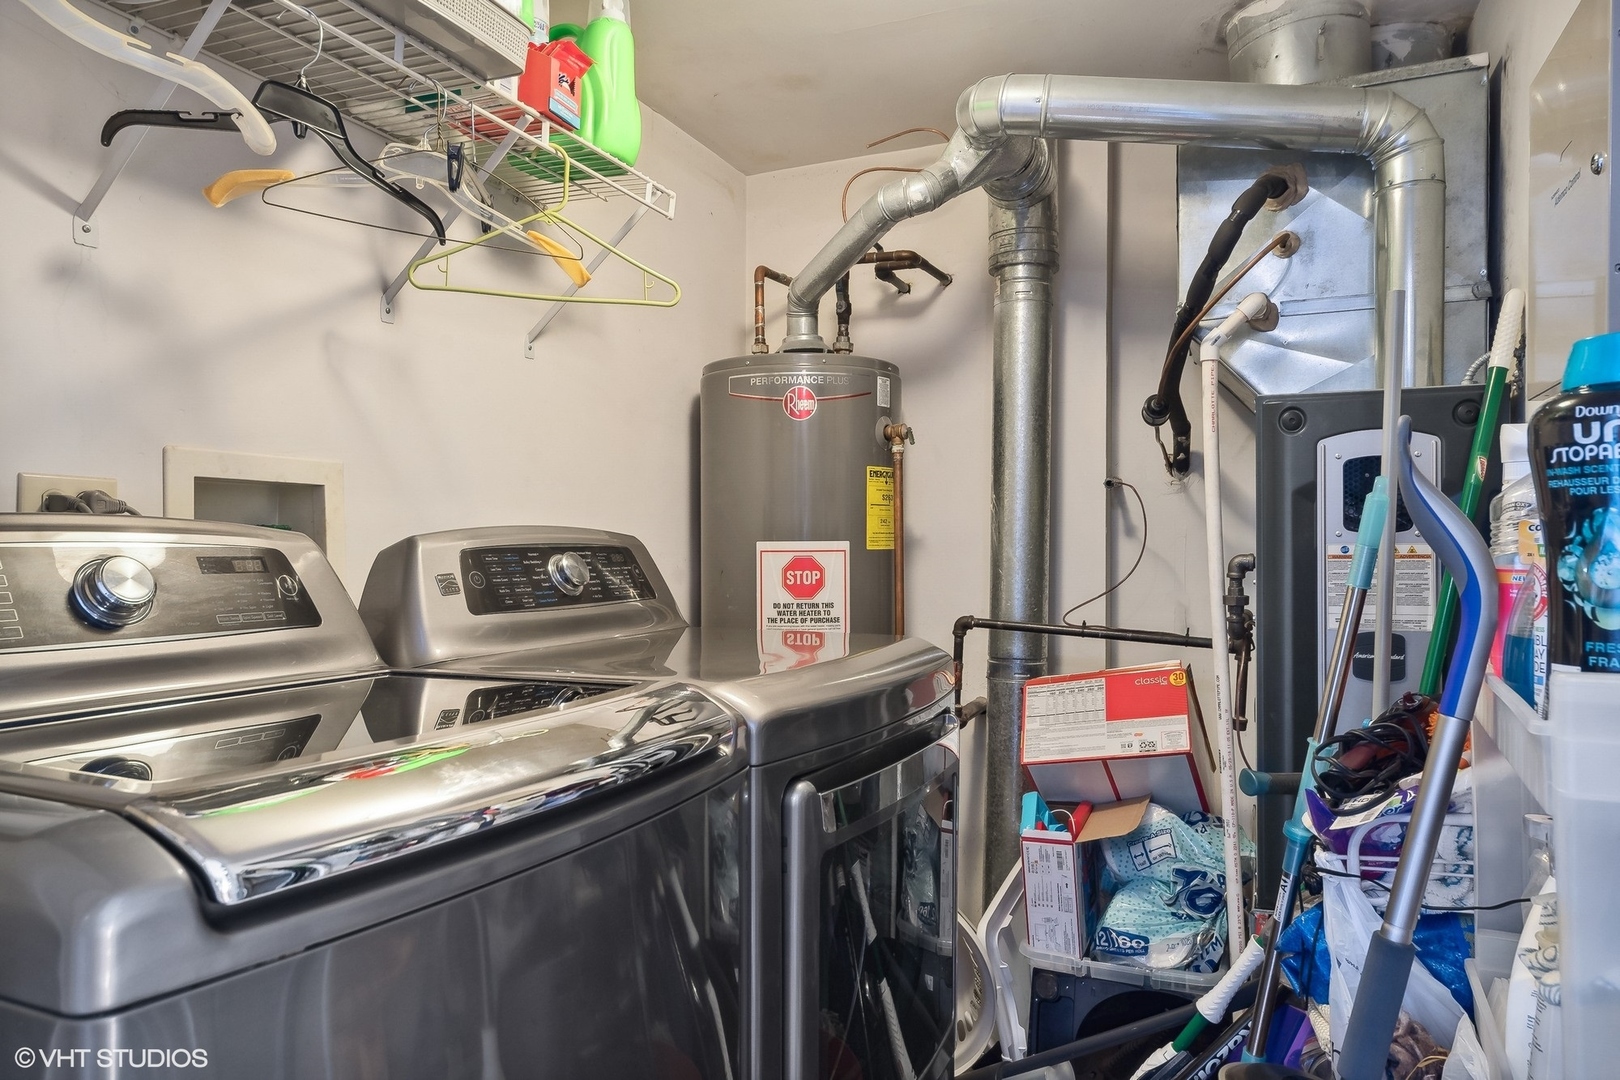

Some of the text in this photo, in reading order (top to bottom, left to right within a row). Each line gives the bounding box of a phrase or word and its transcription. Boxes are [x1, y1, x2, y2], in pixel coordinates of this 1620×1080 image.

[750, 375, 849, 386] PERFORMANCE PLUS
[787, 387, 814, 415] Rheem
[1575, 405, 1620, 418] Down
[1548, 476, 1609, 488] REHAUSSEUR
[1569, 487, 1597, 496] POUR
[786, 570, 821, 585] STOP
[1134, 676, 1168, 686] classic
[1172, 673, 1184, 681] 30
